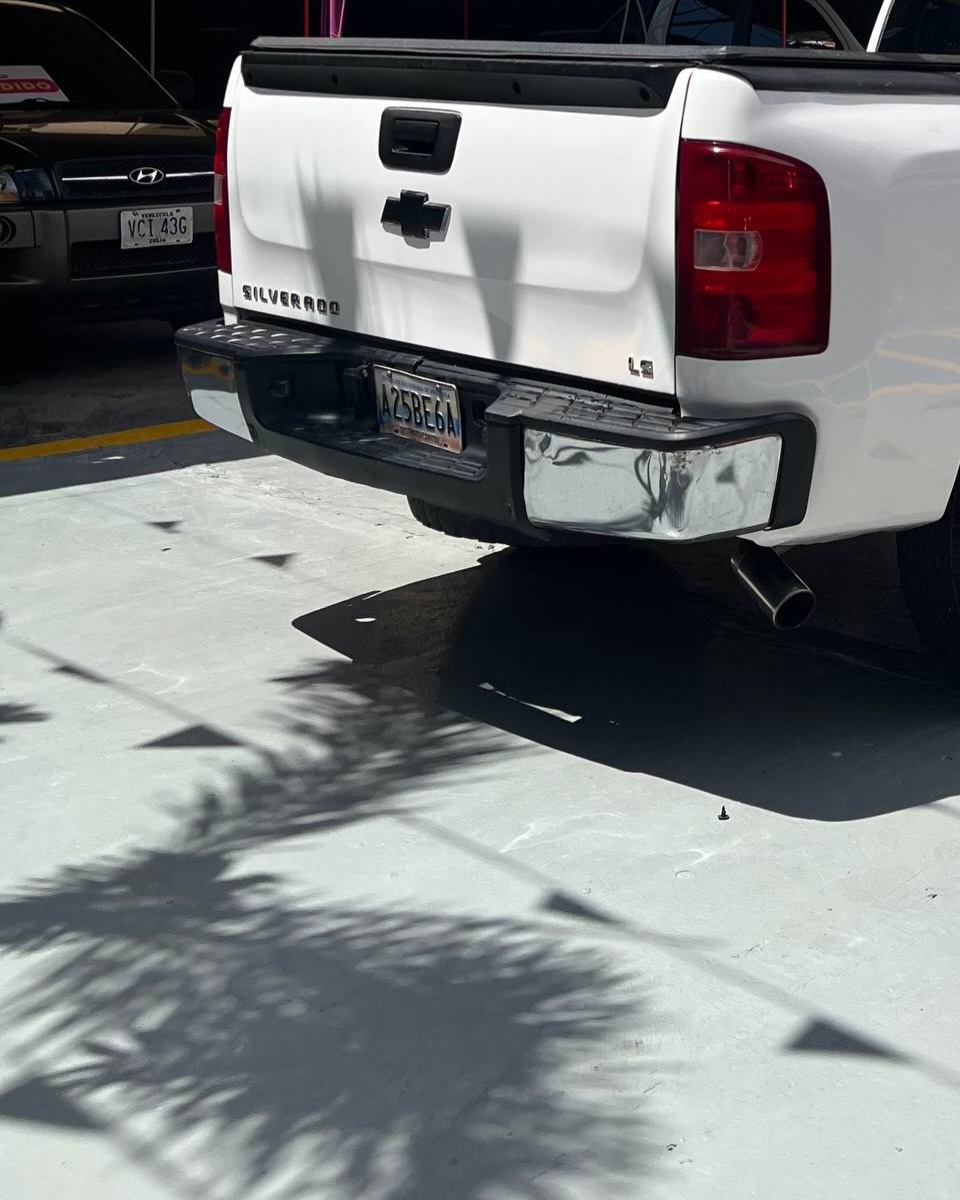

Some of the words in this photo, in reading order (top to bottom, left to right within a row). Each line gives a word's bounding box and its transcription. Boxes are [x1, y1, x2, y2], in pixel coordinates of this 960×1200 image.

[242, 284, 341, 316] SILVERADO
[628, 356, 654, 380] LS
[382, 383, 457, 439] A25BE6A
